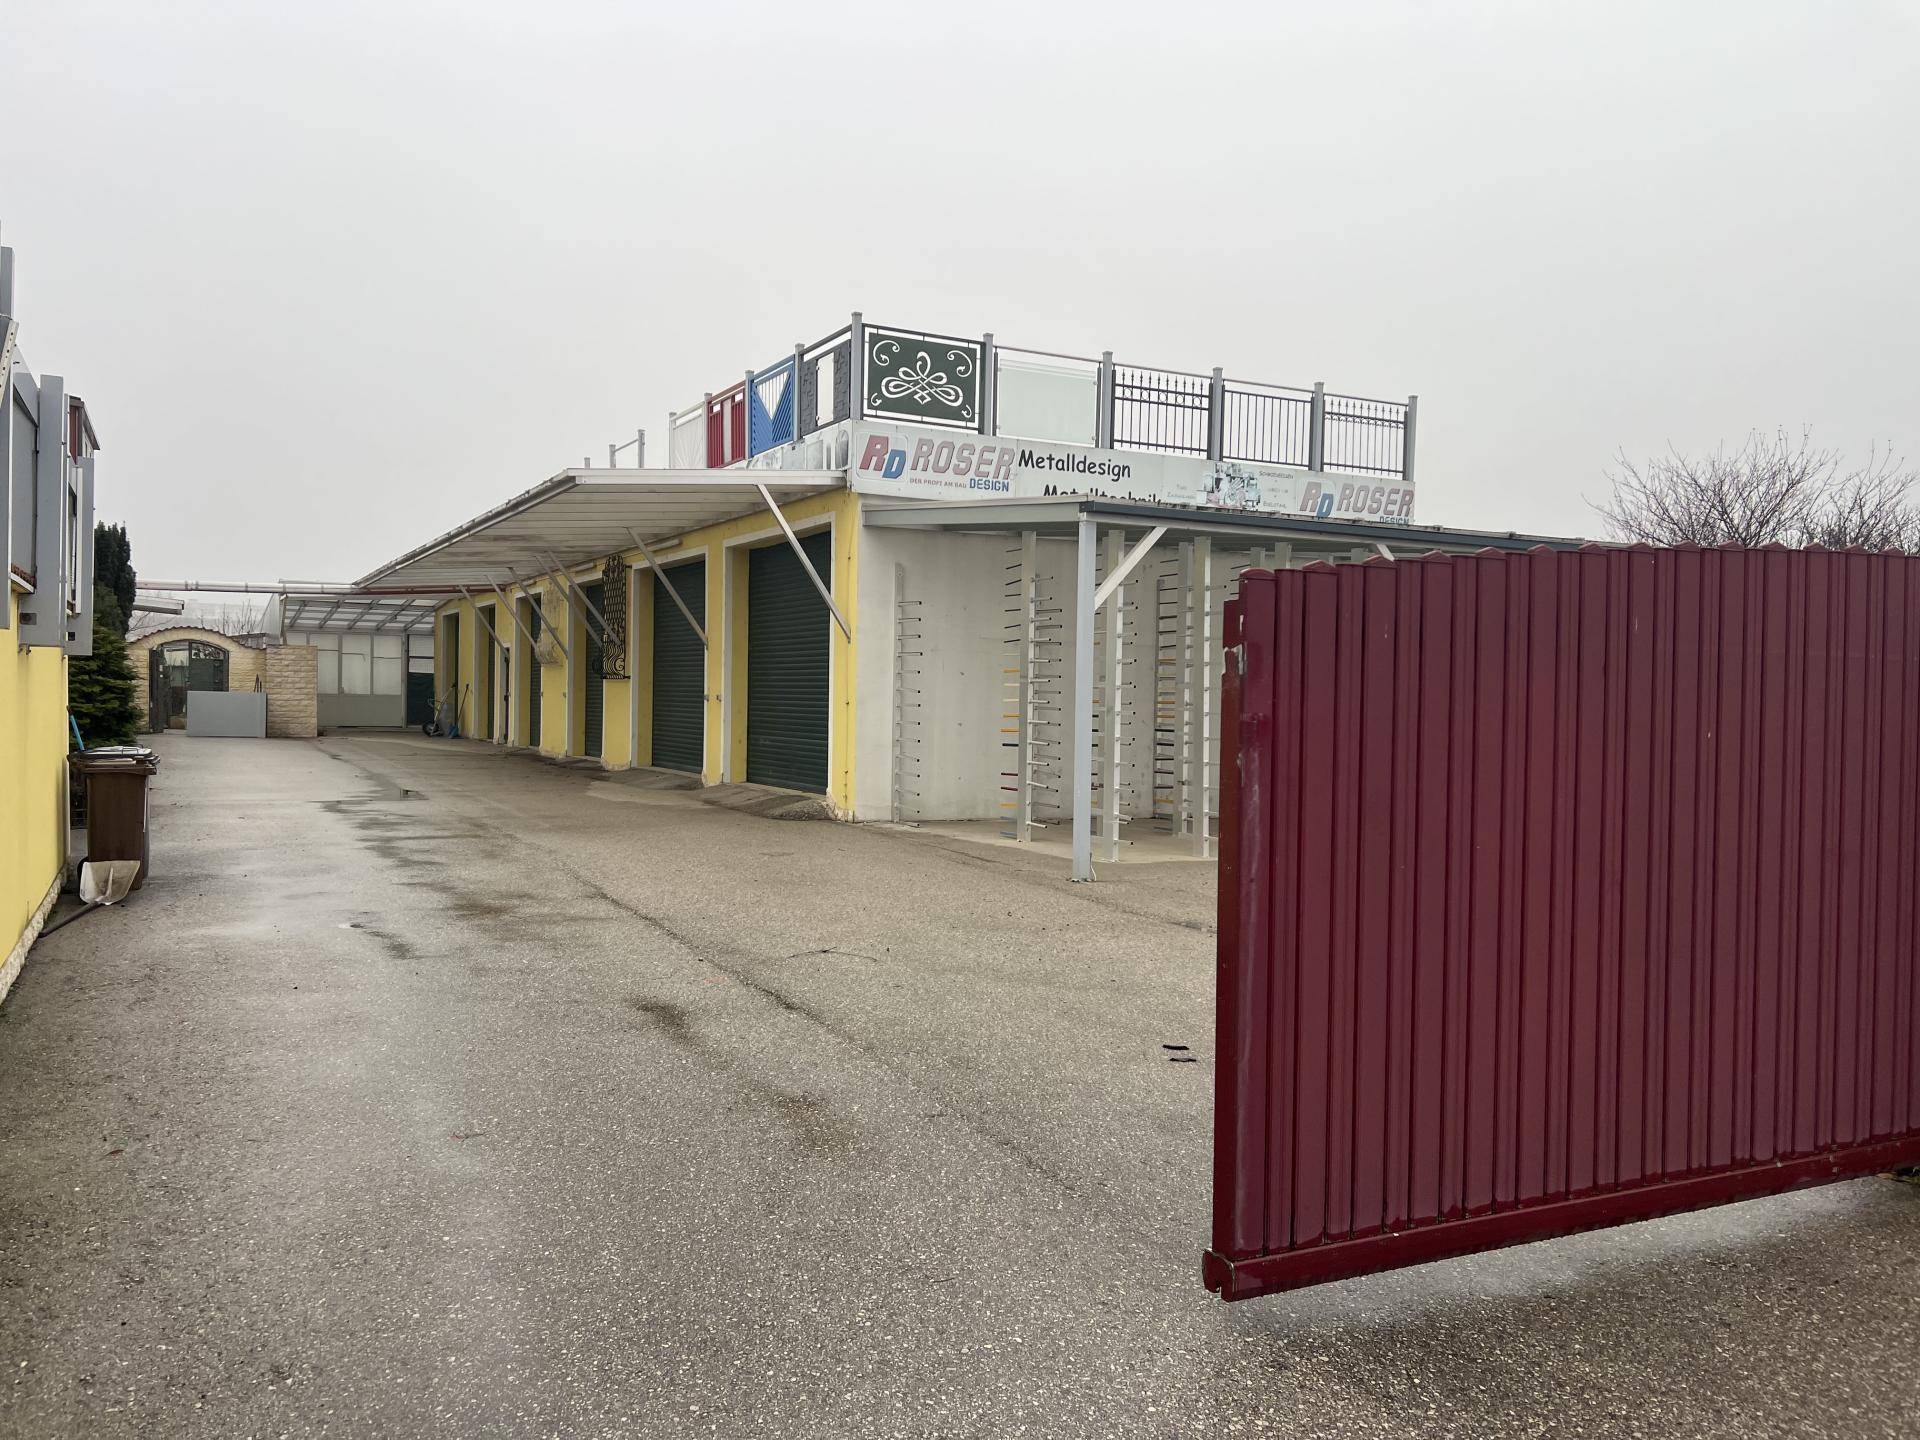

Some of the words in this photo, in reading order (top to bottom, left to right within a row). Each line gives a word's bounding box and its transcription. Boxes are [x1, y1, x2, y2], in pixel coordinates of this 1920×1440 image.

[911, 437, 1016, 480] ROSER
[1018, 449, 1131, 482] Metalldesign
[969, 477, 1009, 492] DESIGN
[1336, 483, 1415, 518] ROSER
